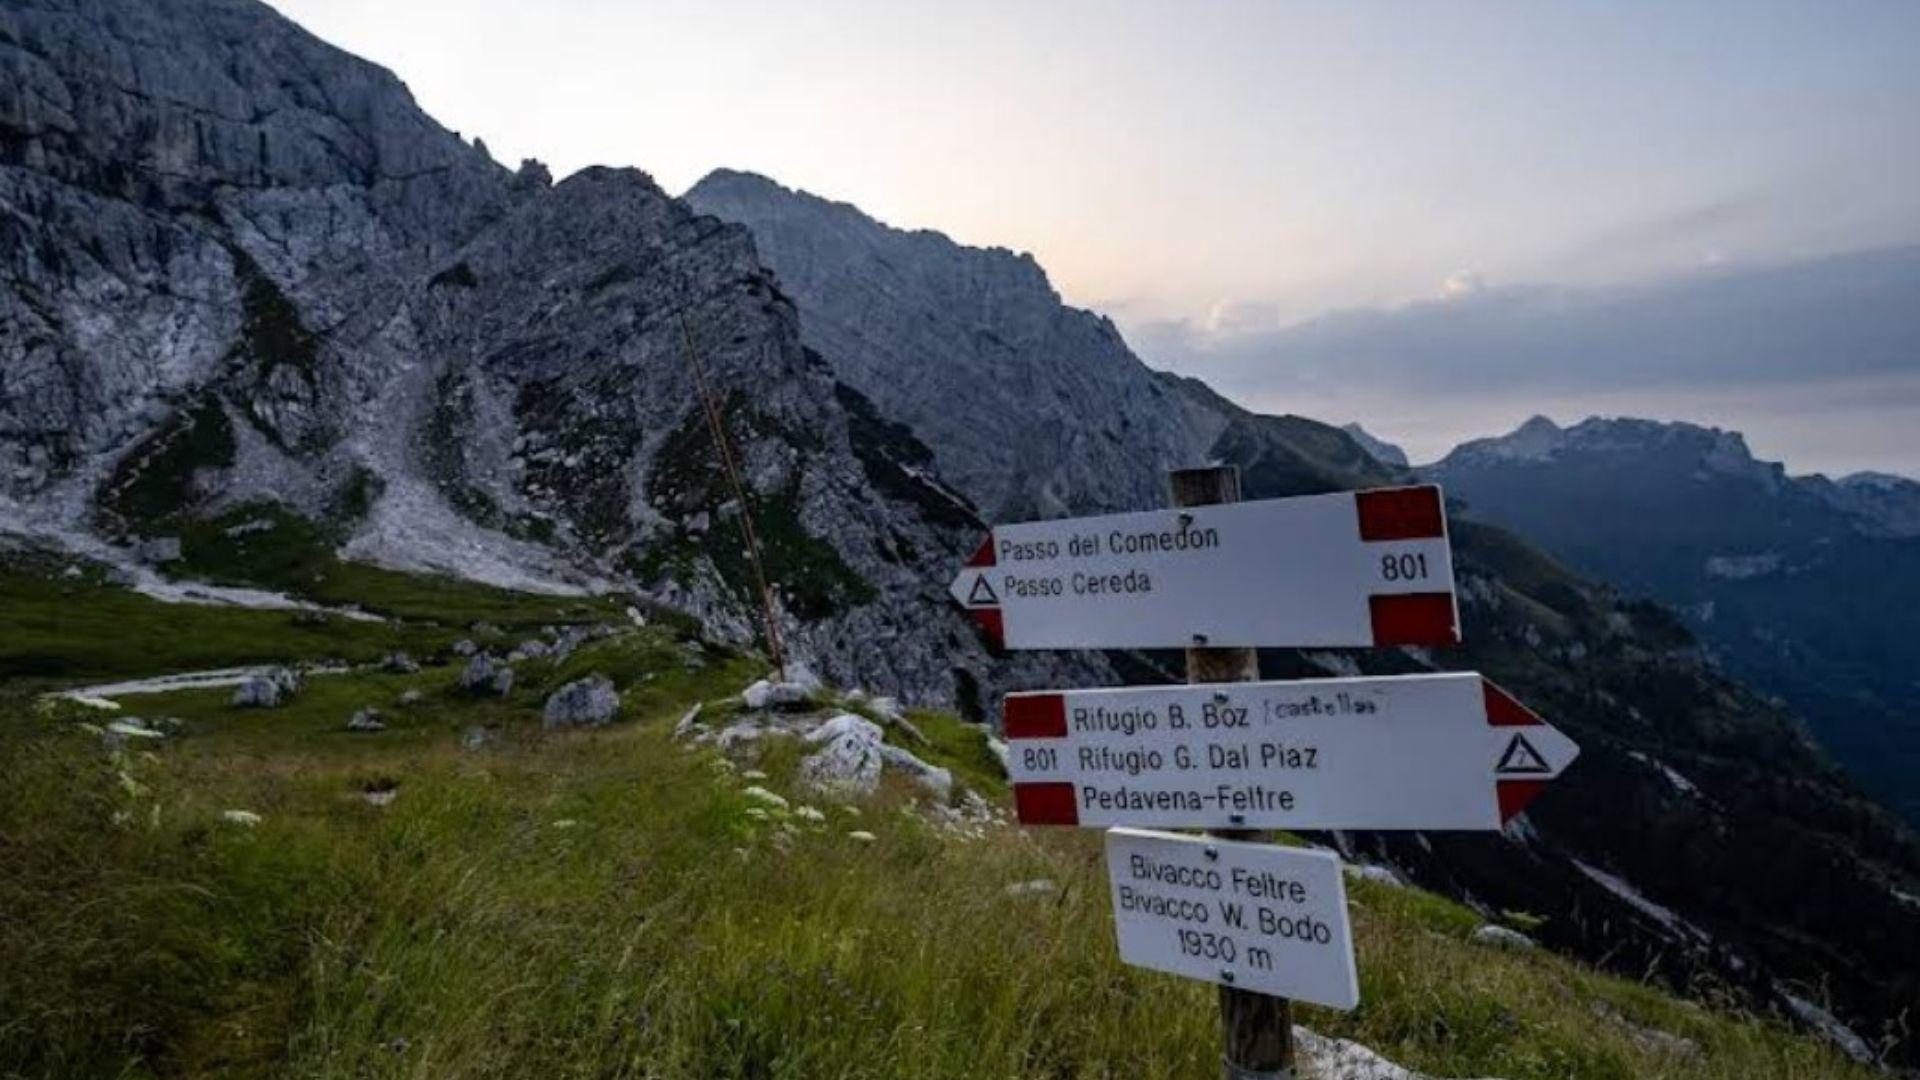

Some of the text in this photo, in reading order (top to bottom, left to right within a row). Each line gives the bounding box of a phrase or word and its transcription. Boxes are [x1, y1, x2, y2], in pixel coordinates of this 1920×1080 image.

[1001, 524, 1220, 561] Passo del Comedon
[1005, 572, 1151, 596] Passo Cereda
[1381, 553, 1429, 581] 801
[1074, 700, 1250, 736] Rifugio B. Boz
[1023, 749, 1058, 772] 801
[1078, 740, 1319, 774] Rifugio G. Dal Piaz
[1083, 783, 1294, 813] Pedavena-Feltre
[1131, 854, 1306, 903] Bivacco Feltre
[1119, 885, 1332, 945] Bivacco W. Bodo
[1177, 928, 1273, 972] 1930 m
